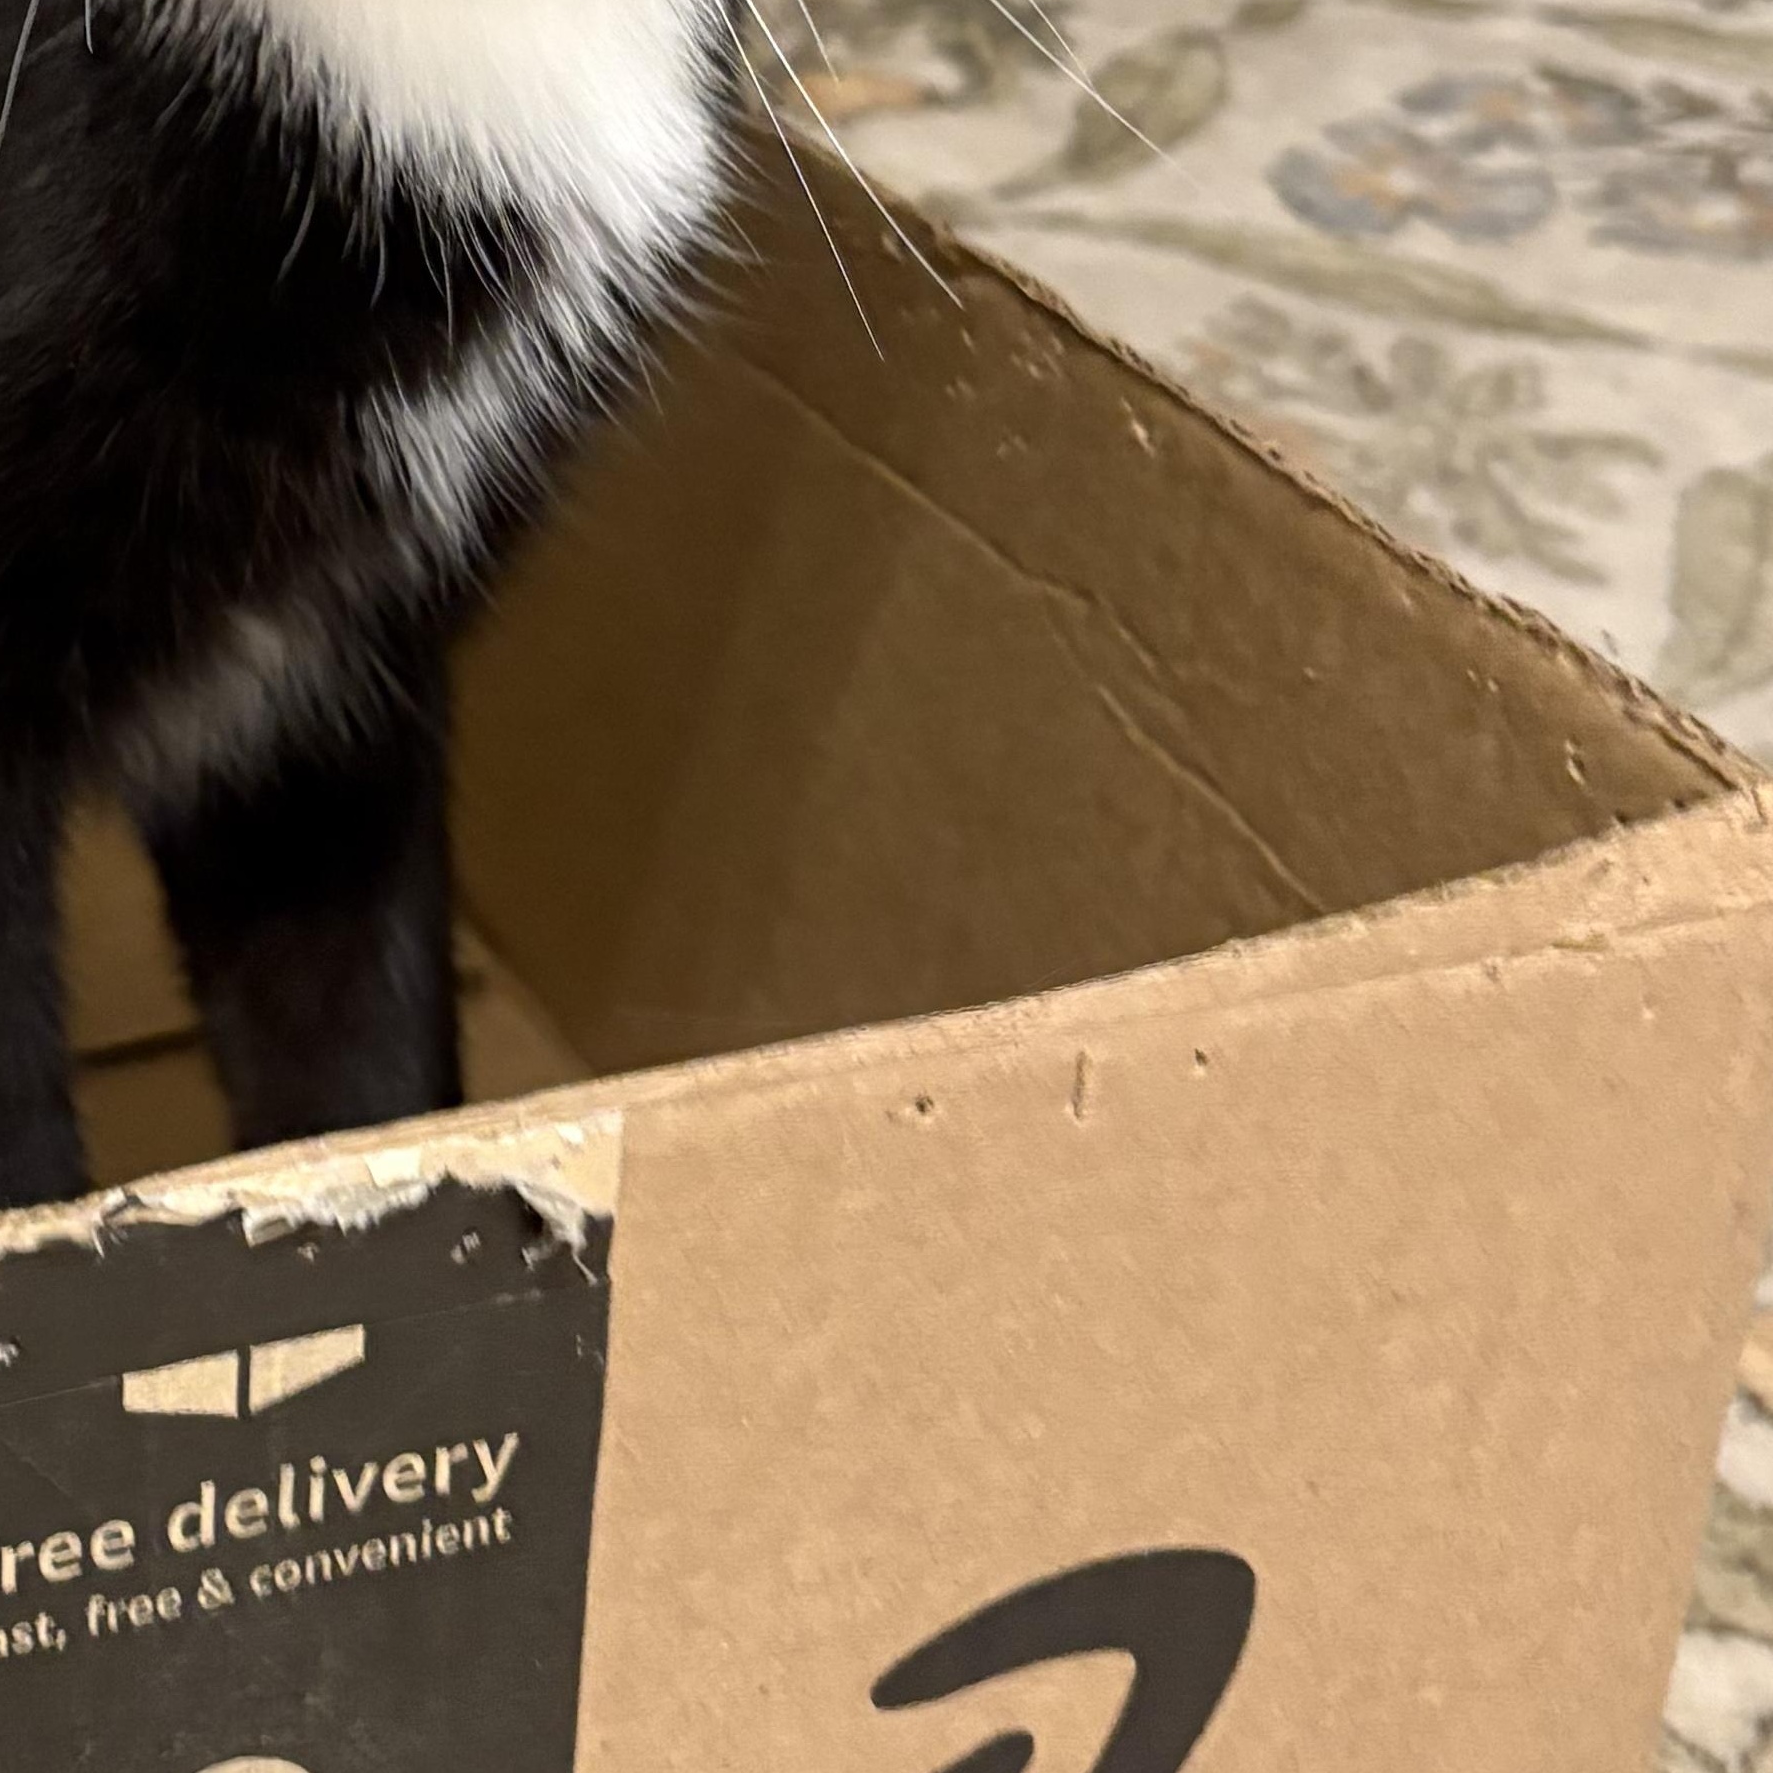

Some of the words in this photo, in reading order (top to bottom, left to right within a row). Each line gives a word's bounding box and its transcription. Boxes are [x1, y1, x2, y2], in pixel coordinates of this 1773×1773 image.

[167, 1431, 521, 1554] delivery
[86, 1587, 182, 1638] free
[197, 1568, 235, 1610] &
[248, 1506, 512, 1600] convenient
